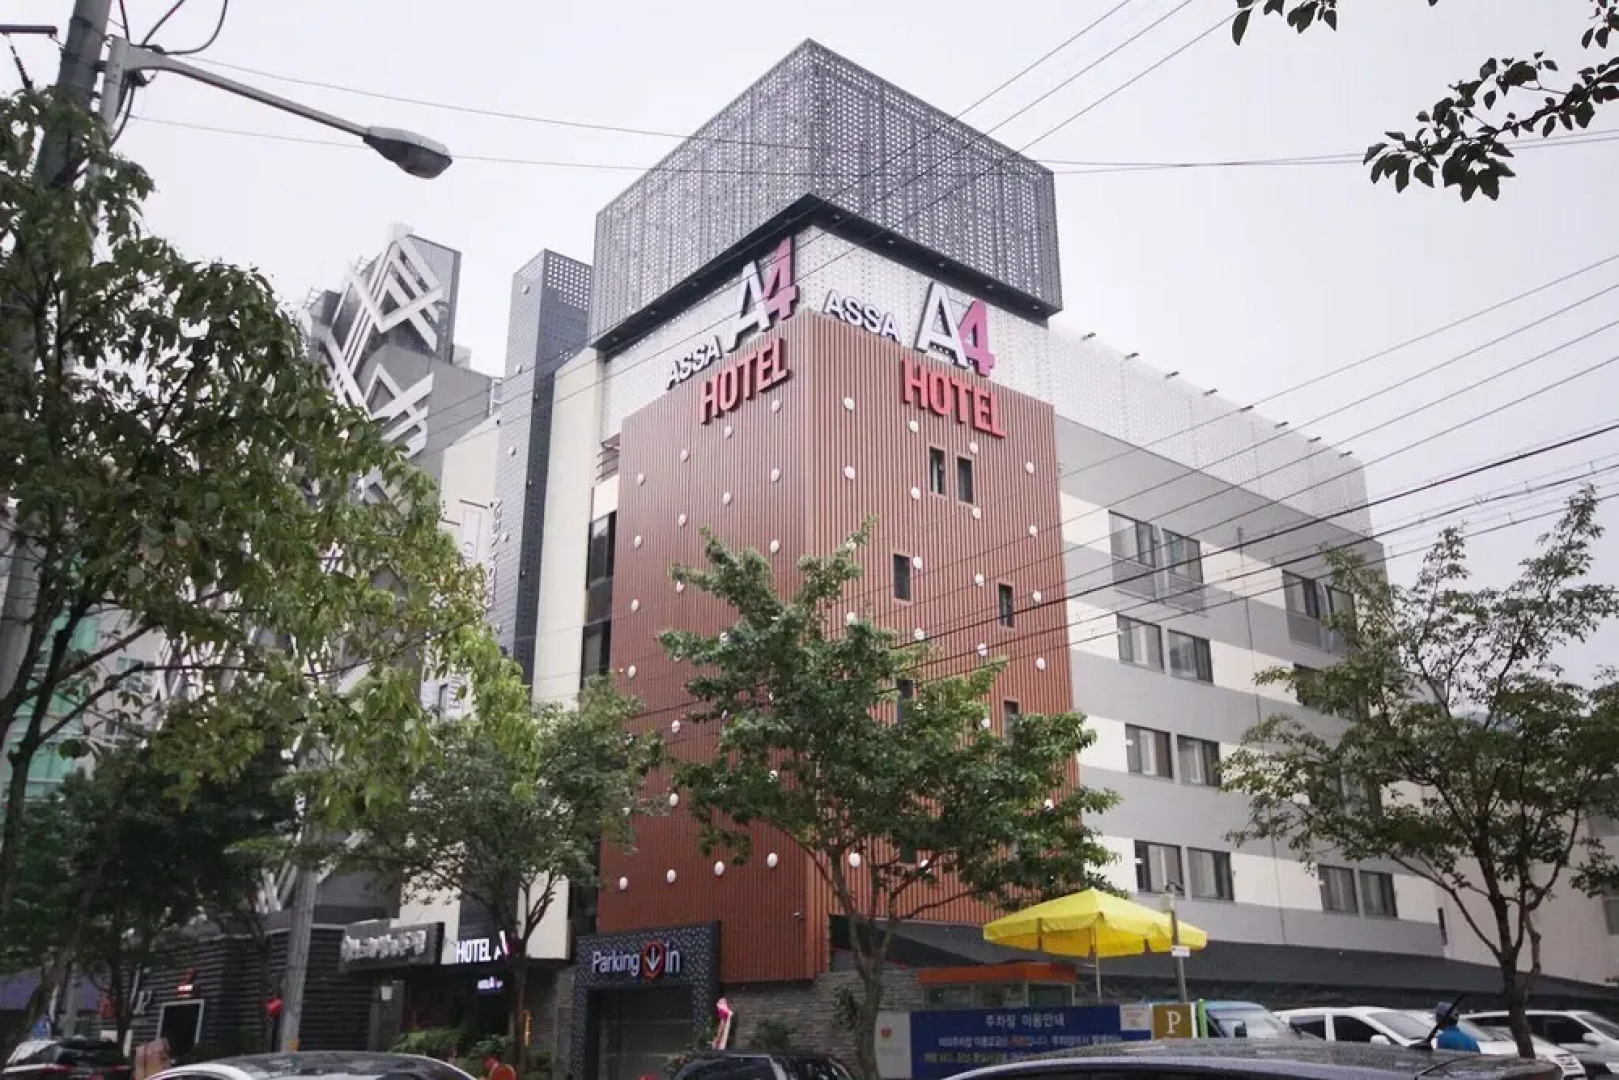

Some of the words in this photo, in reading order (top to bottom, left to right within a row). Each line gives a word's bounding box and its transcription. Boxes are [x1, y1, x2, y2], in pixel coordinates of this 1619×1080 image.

[667, 335, 722, 389] ASSA
[726, 235, 798, 353] A4
[823, 289, 901, 342] ASSA
[914, 281, 995, 376] A4
[701, 337, 791, 425] HOTEL
[900, 357, 1006, 438] HOTEL
[456, 938, 492, 963] HOTEL
[592, 951, 640, 977] Parking
[665, 945, 681, 973] in
[985, 1014, 1016, 1029] 주차장
[1021, 1012, 1065, 1029] 이용안내
[1165, 1010, 1182, 1034] P
